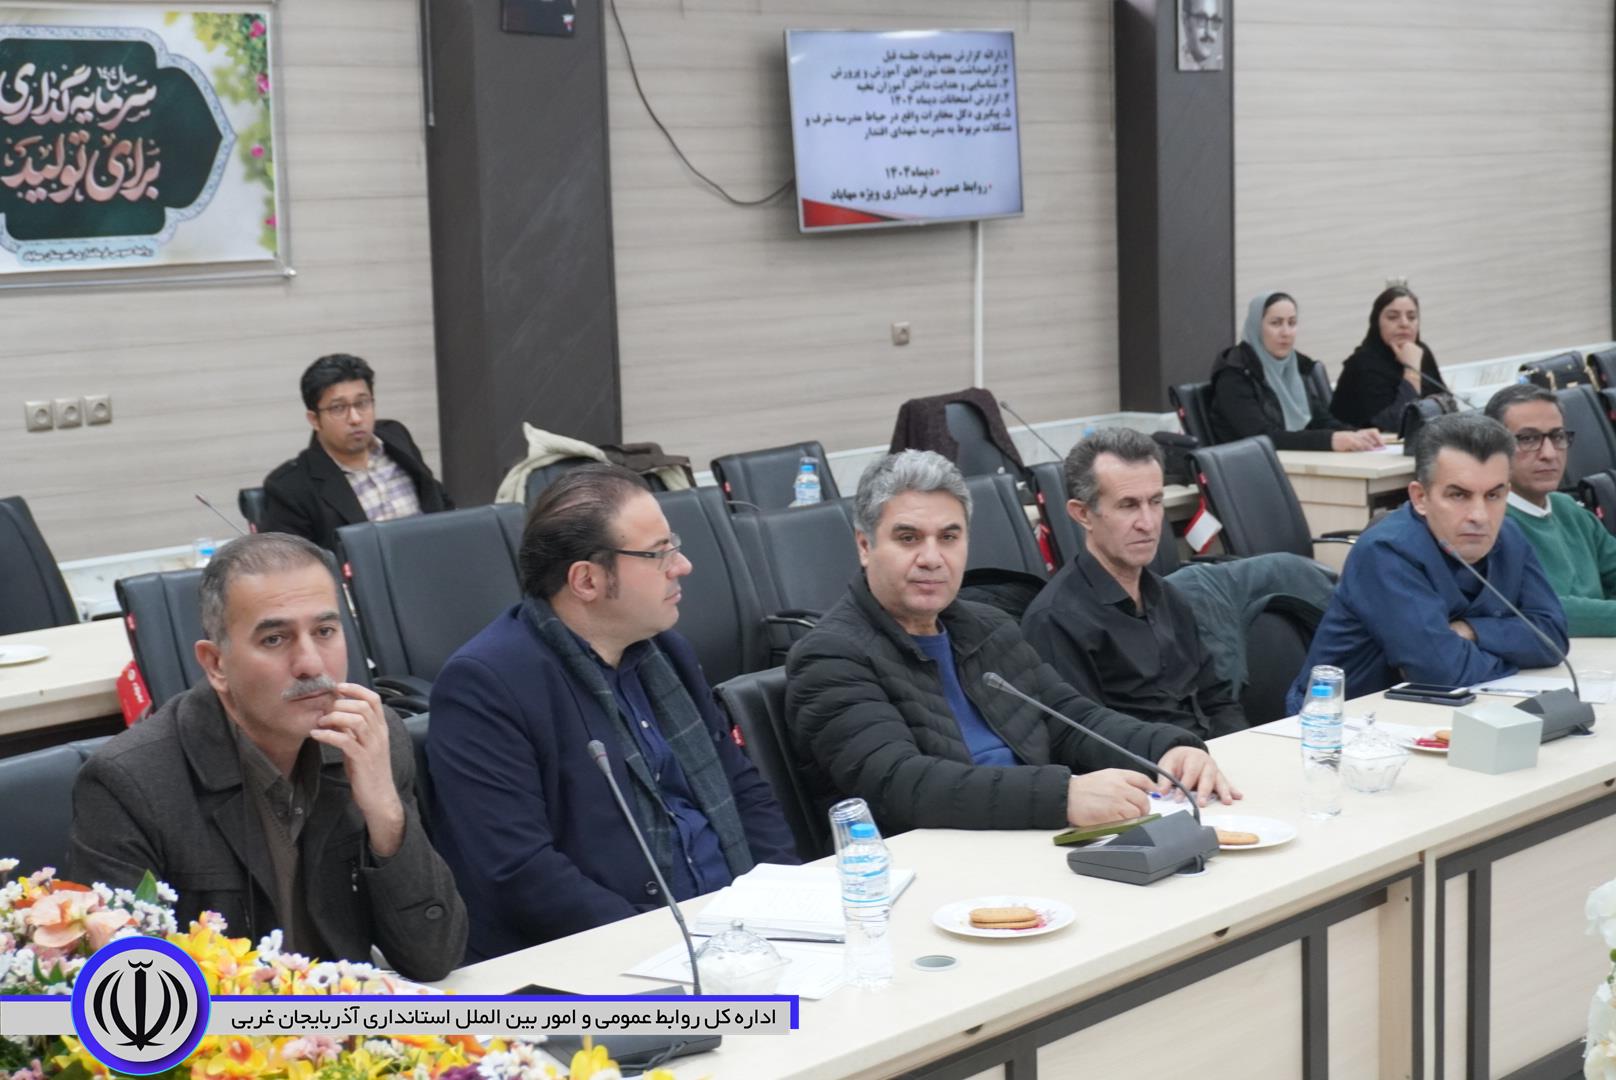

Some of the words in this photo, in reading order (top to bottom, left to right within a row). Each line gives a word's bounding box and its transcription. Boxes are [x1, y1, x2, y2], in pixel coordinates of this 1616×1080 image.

[883, 51, 897, 63] قبل
[899, 52, 919, 60] جلسه
[923, 51, 952, 62] مصوبات
[954, 50, 981, 62] گزارش
[831, 68, 860, 79] پرورش
[864, 70, 868, 79] و
[871, 65, 900, 79] آموزش
[877, 81, 905, 93] آموزان
[909, 82, 931, 93] دانش
[961, 84, 965, 92] و
[968, 81, 998, 92] شناسایی
[940, 95, 972, 104] امتحانات
[836, 115, 862, 124] مدرسه
[890, 114, 899, 123] در
[922, 112, 953, 123] مخابرات
[920, 127, 945, 136] مدرسه
[956, 124, 981, 134] مربوط
[984, 123, 1012, 133] مشکلات
[0, 130, 90, 203] تولید
[85, 136, 160, 202] برای
[860, 189, 880, 200] ویژه
[884, 185, 927, 199] فرمانداری
[932, 186, 959, 197] عمومی
[961, 184, 987, 194] روابط
[830, 191, 856, 200] مهاباد
